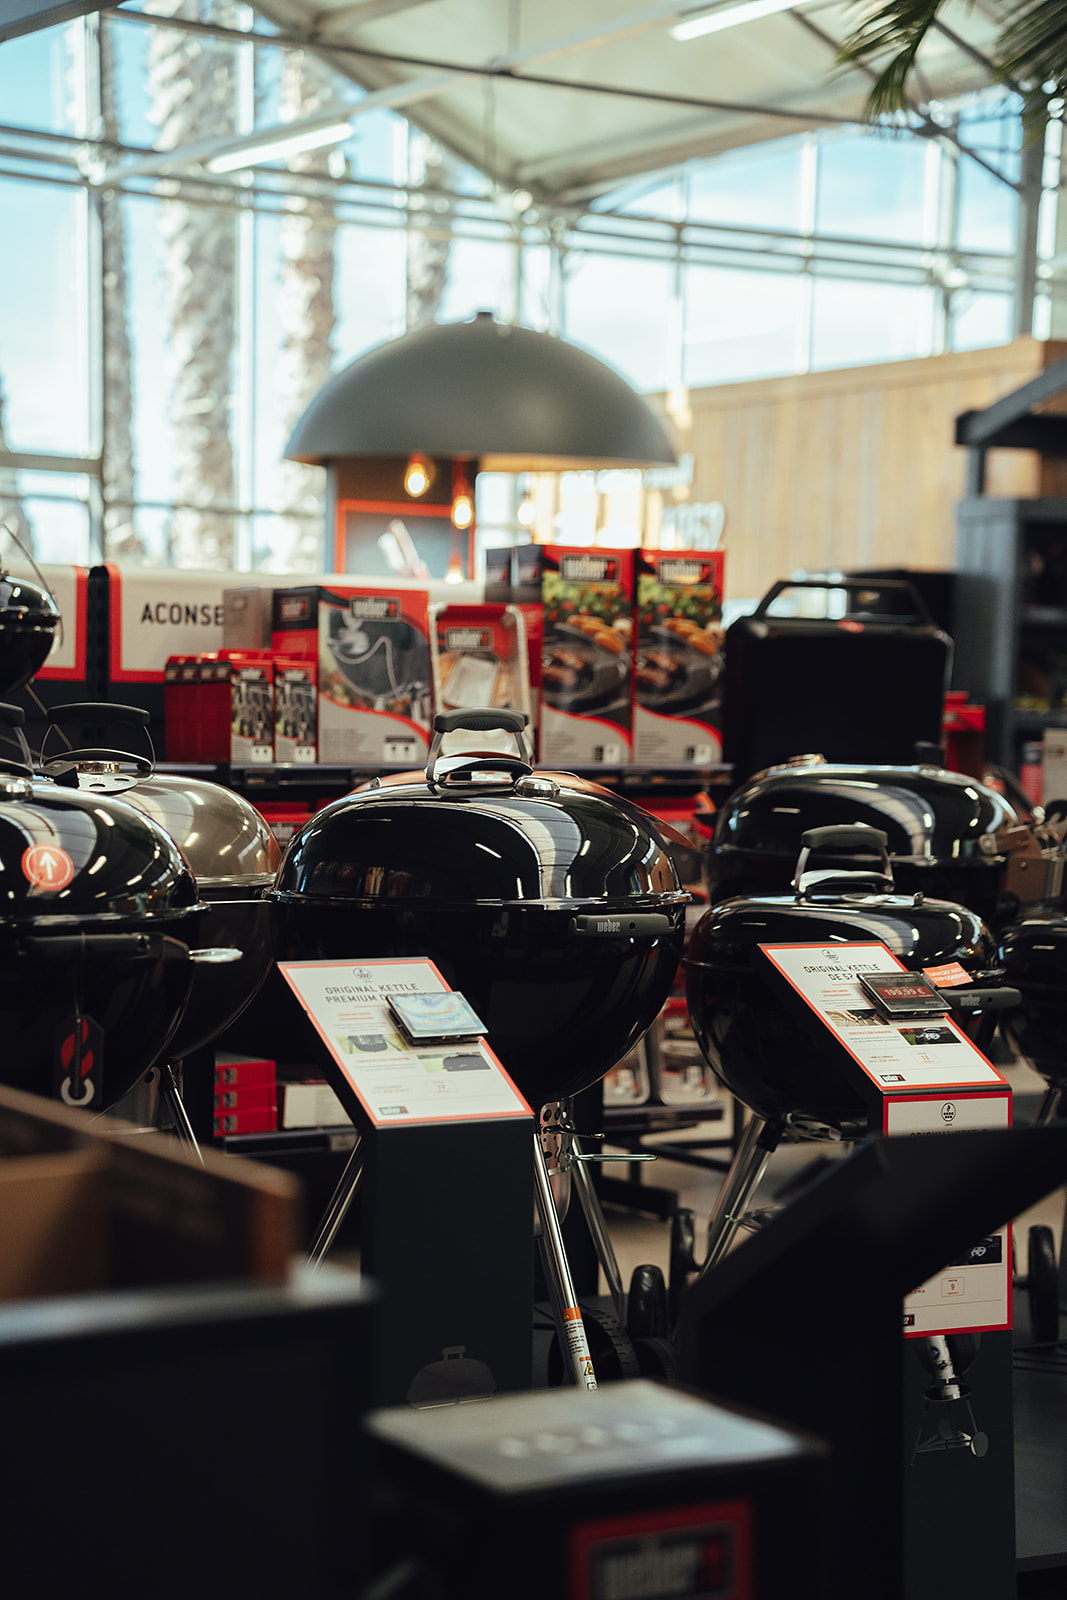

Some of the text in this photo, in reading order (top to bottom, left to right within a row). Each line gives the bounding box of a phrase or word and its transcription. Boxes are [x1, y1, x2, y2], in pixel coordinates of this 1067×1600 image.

[141, 603, 224, 626] ACONSE
[597, 919, 620, 932] weber
[803, 965, 847, 973] ORIGINAL
[325, 983, 419, 995] ORIGINAL KETTLE
[325, 994, 378, 1003] PREMIUM
